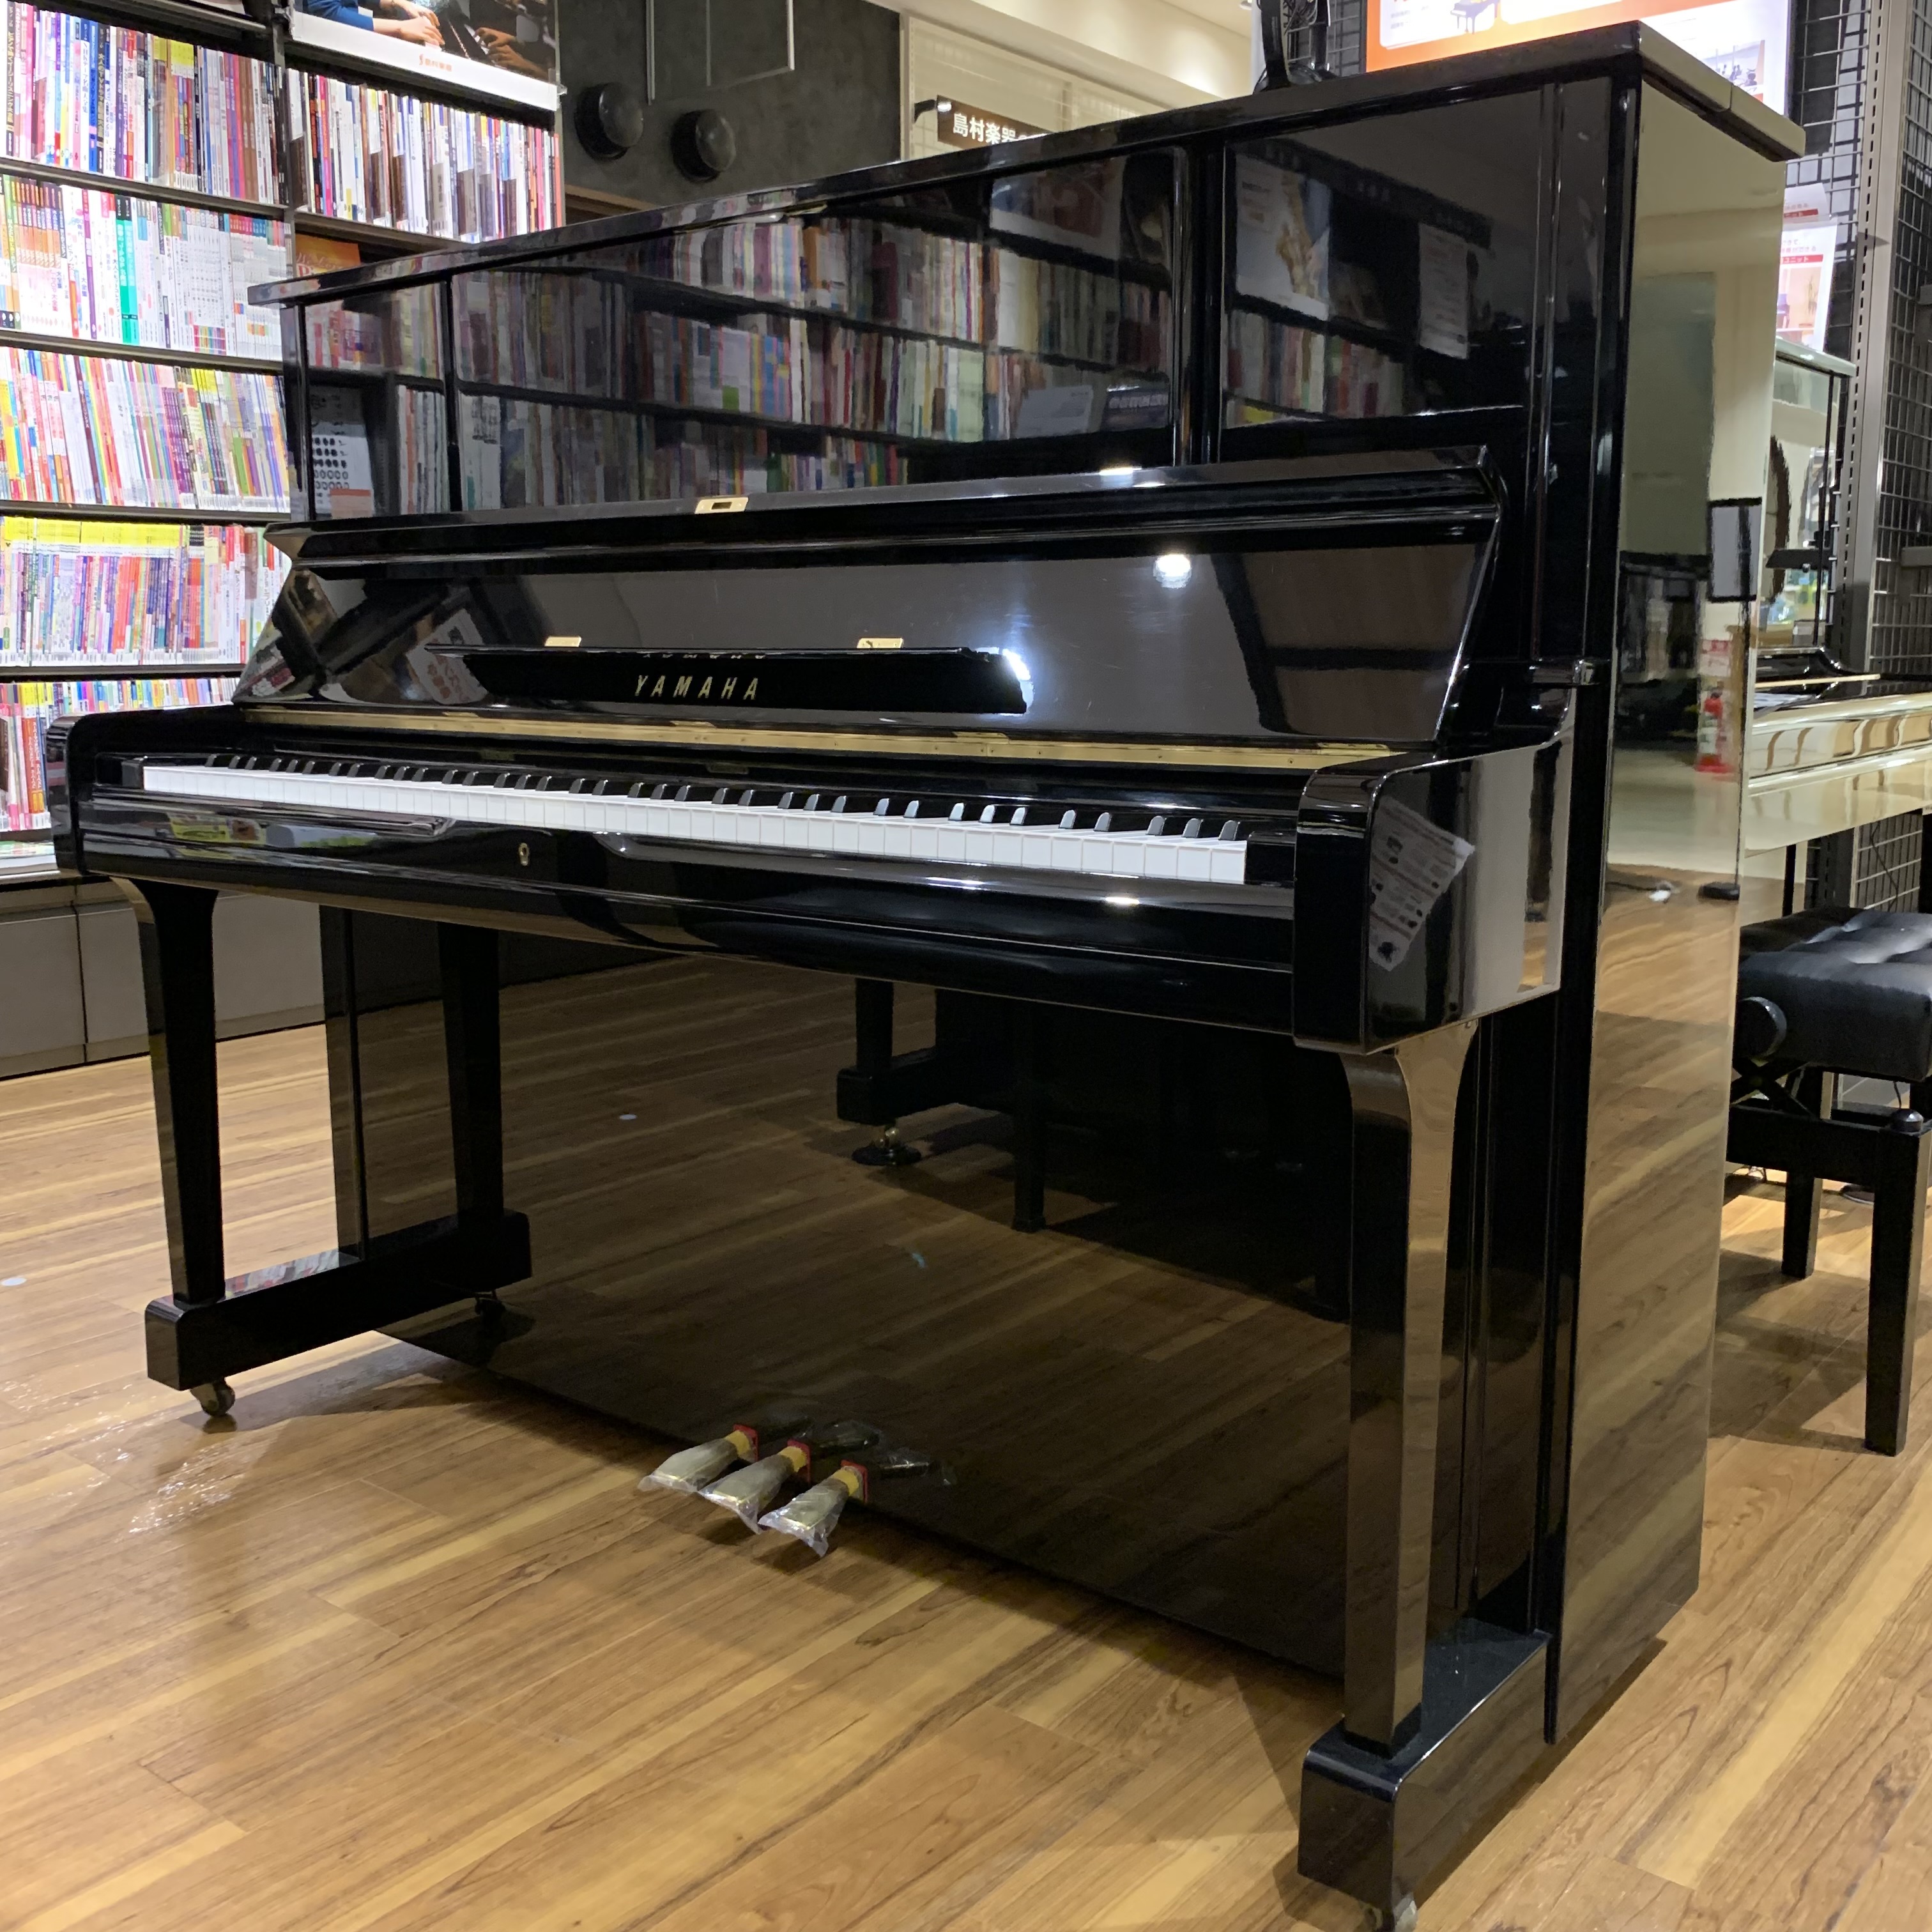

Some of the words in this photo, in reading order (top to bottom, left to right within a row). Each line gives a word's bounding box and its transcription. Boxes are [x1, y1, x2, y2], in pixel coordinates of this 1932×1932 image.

[953, 113, 1028, 144] 島村楽器
[635, 675, 758, 700] YAMAHA
